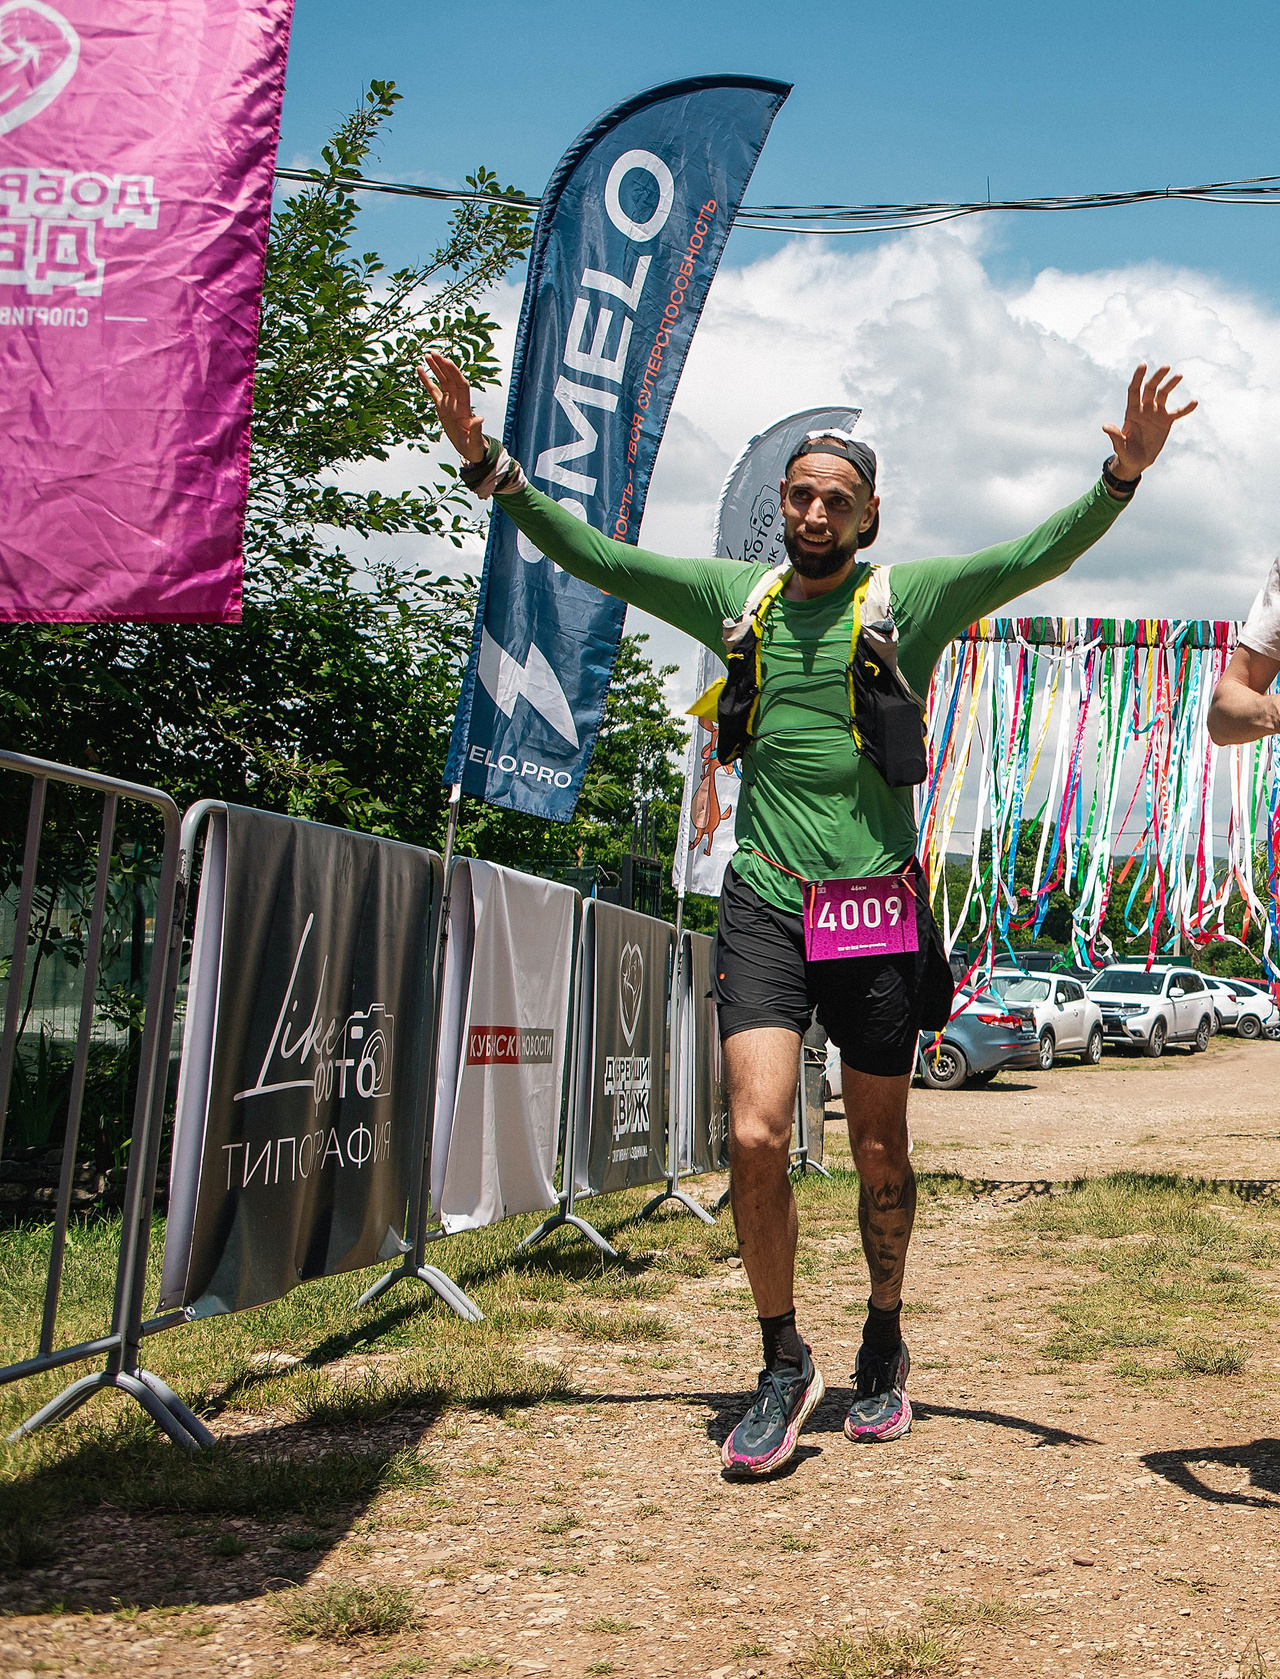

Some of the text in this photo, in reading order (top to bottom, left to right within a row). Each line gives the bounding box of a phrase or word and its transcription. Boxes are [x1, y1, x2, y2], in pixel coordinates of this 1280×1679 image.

[626, 411, 646, 465] ТВОЯ
[638, 199, 717, 410] СУПЕРСПОСОБНОСТЬ
[467, 743, 573, 789] ELO.PRO
[817, 896, 902, 932] 4009
[234, 912, 338, 1101] Like
[222, 1121, 391, 1191] ТИПОГРАФИЯ
